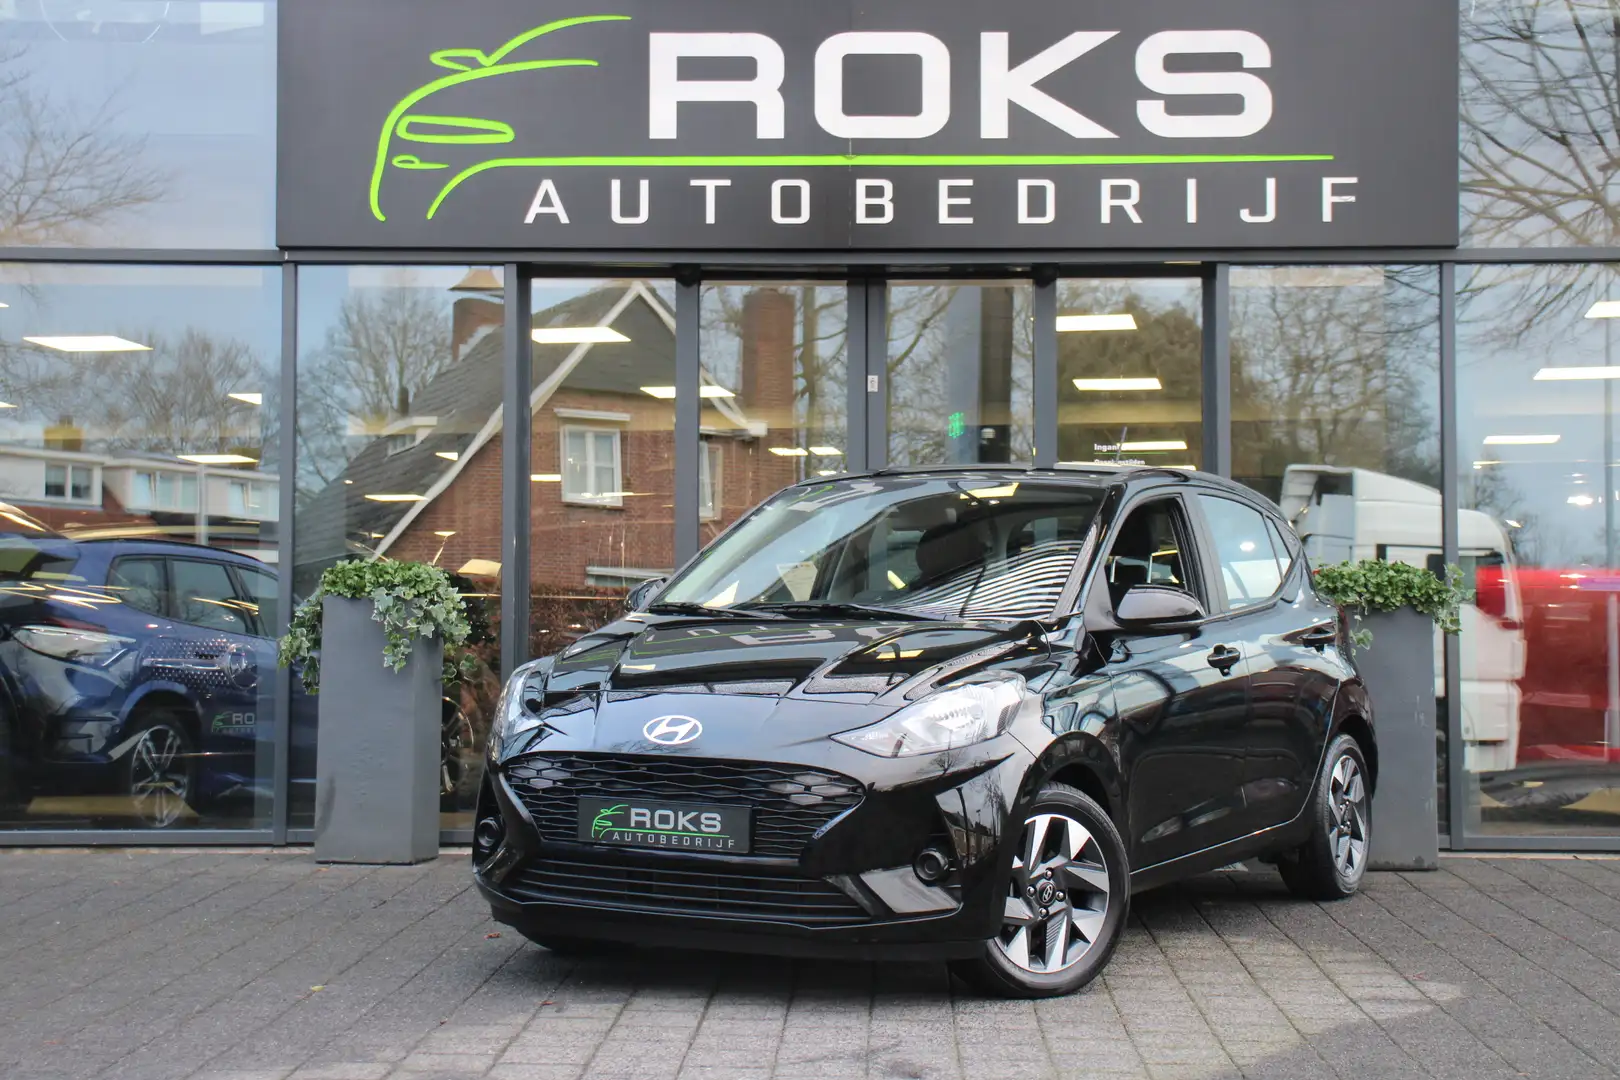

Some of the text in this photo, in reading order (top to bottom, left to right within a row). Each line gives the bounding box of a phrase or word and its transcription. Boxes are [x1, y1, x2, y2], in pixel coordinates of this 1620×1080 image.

[649, 30, 1272, 139] ROKS
[524, 177, 1358, 225] AUTOBEDRIJF
[1094, 443, 1120, 452] Ingan
[232, 712, 255, 725] RO
[630, 808, 722, 833] ROKS
[612, 832, 736, 849] AUTOBEDRIJF
